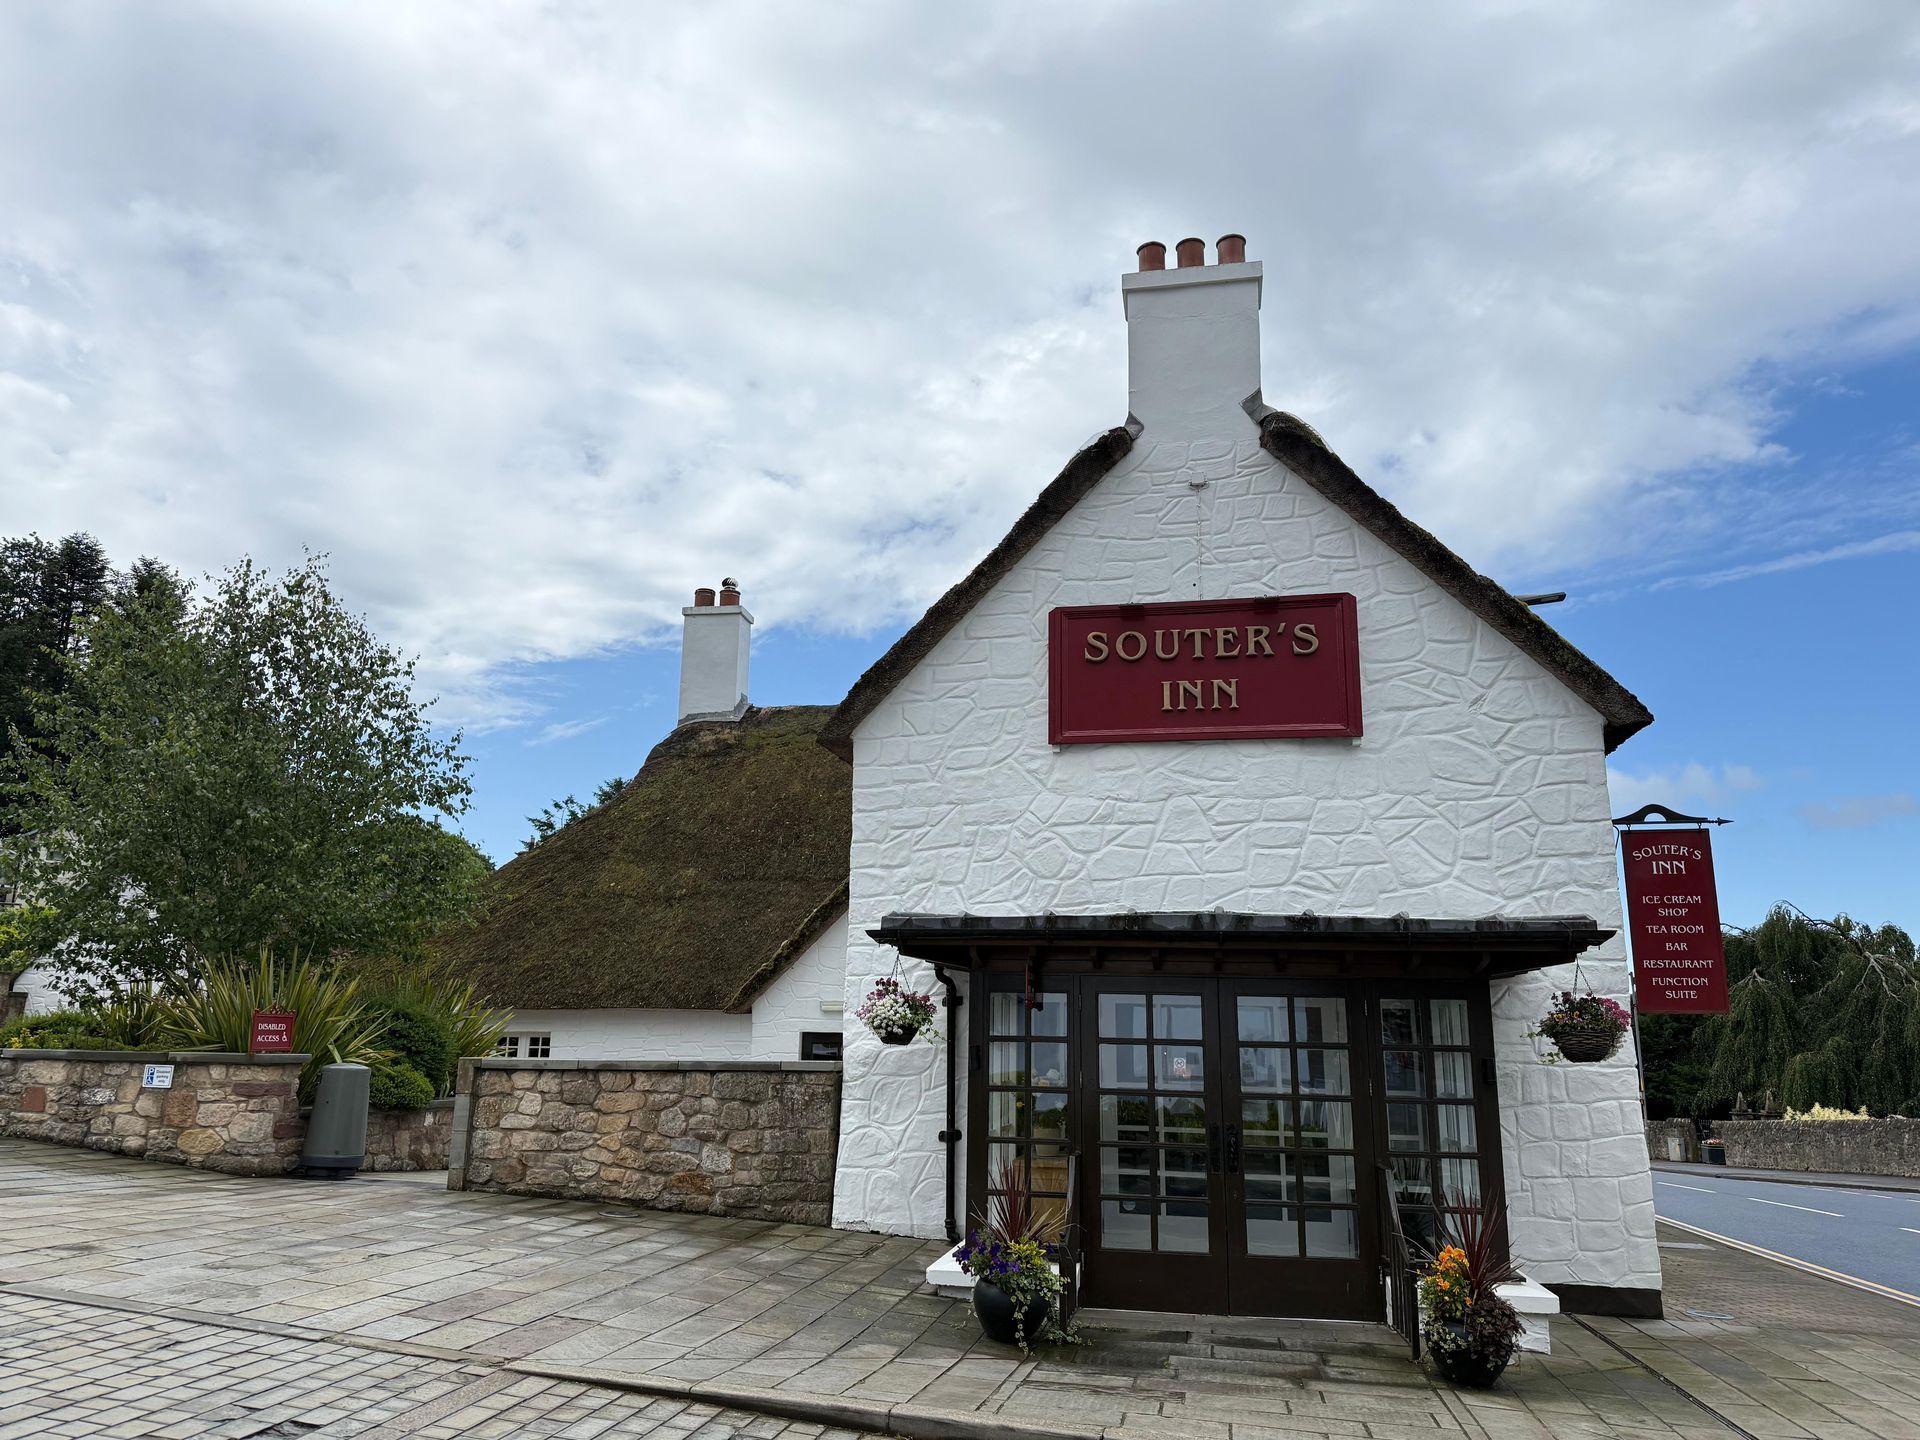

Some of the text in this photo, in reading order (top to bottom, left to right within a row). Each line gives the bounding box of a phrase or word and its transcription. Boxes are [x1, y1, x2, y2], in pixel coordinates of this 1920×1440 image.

[1084, 622, 1319, 662] SOUTER'S
[1160, 678, 1239, 711] INN
[1632, 844, 1702, 861] SOUTER'S
[1651, 860, 1687, 875] INN
[1642, 895, 1702, 904] ICE CREAM
[1657, 907, 1689, 917] SHOP
[1645, 925, 1704, 934] TEA ROOM
[1665, 942, 1688, 951] BAR
[1642, 959, 1714, 969] RESTAURANT
[1652, 977, 1709, 986] FUNCTION
[1665, 990, 1698, 999] SUITE
[258, 1023, 286, 1031] DISABLED
